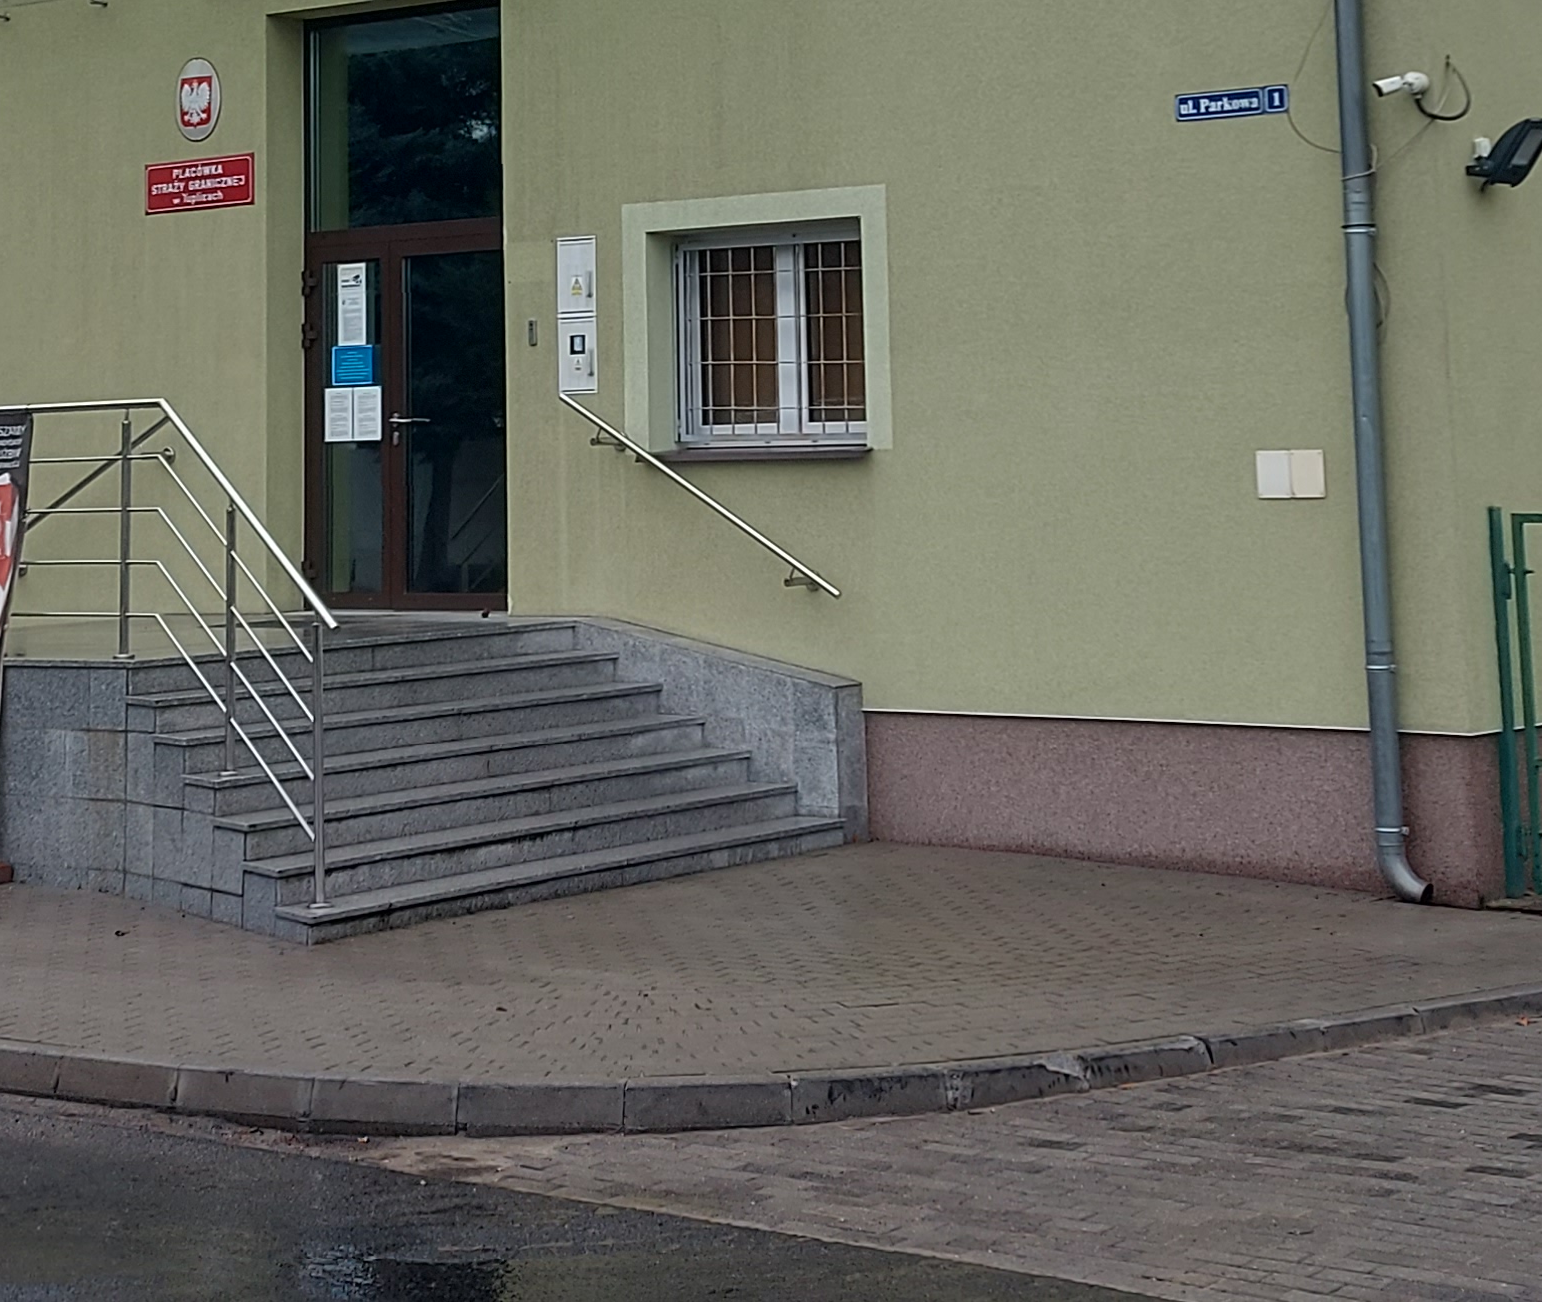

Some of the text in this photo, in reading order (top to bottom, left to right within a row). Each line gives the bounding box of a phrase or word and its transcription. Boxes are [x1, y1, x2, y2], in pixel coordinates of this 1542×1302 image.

[1199, 97, 1259, 114] Parkowa
[1272, 91, 1281, 107] 1
[173, 164, 223, 179] PLACÓWKA
[151, 175, 245, 196] STRAŻY GRANICZNEJ
[182, 191, 223, 205] Tuplicach
